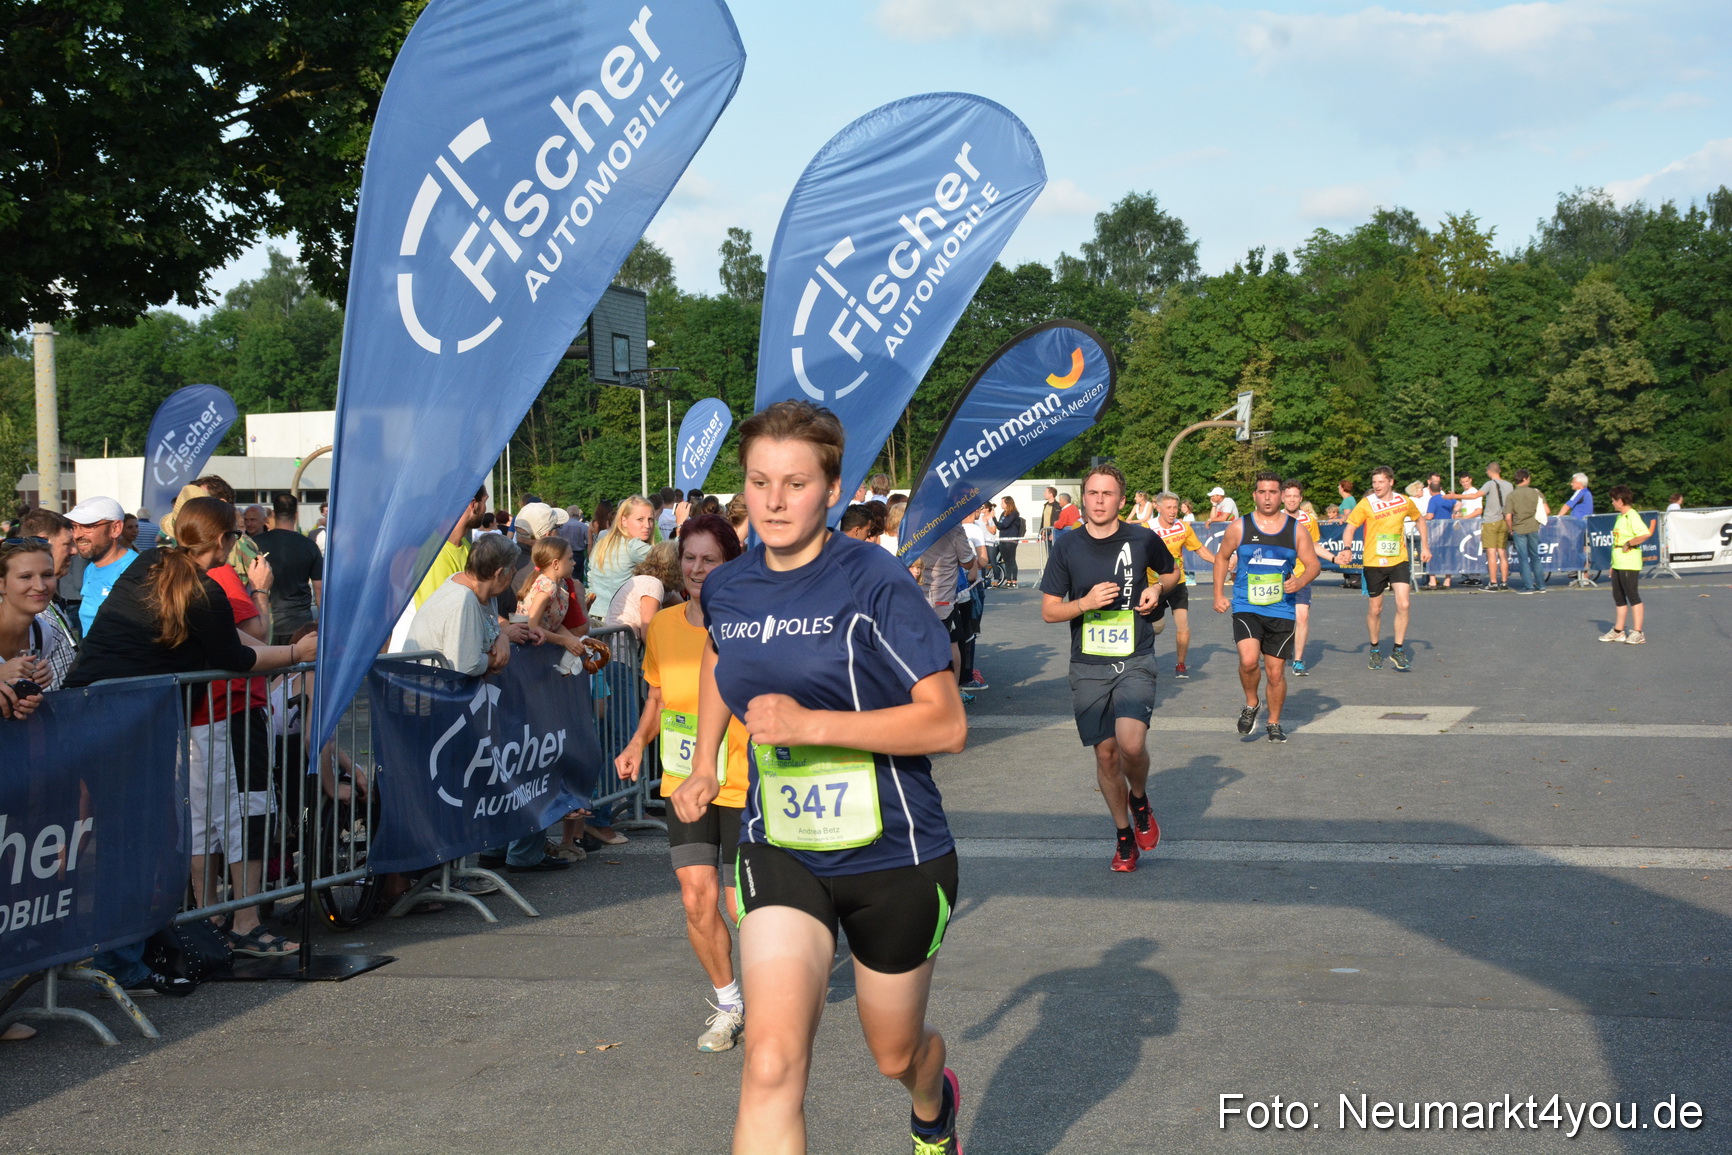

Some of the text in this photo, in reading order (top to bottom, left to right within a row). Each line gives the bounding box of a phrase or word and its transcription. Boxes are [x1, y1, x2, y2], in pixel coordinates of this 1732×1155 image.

[450, 5, 661, 304] Fischer
[522, 66, 685, 303] AUTOMOBILE
[828, 141, 981, 363] Fischer
[883, 181, 1000, 358] AUTOMOBILE
[166, 400, 217, 473] Fischer
[183, 414, 223, 472] AUTOMOBILE
[689, 411, 720, 469] Fischer
[935, 392, 1062, 488] Frischmann
[1018, 421, 1049, 447] Druck
[1067, 383, 1104, 414] Medien
[1381, 542, 1397, 551] 932
[1252, 585, 1280, 597] 1345
[1088, 627, 1129, 643] 1154
[680, 739, 696, 760] 5
[780, 781, 849, 819] 347
[798, 827, 822, 835] Andrea
